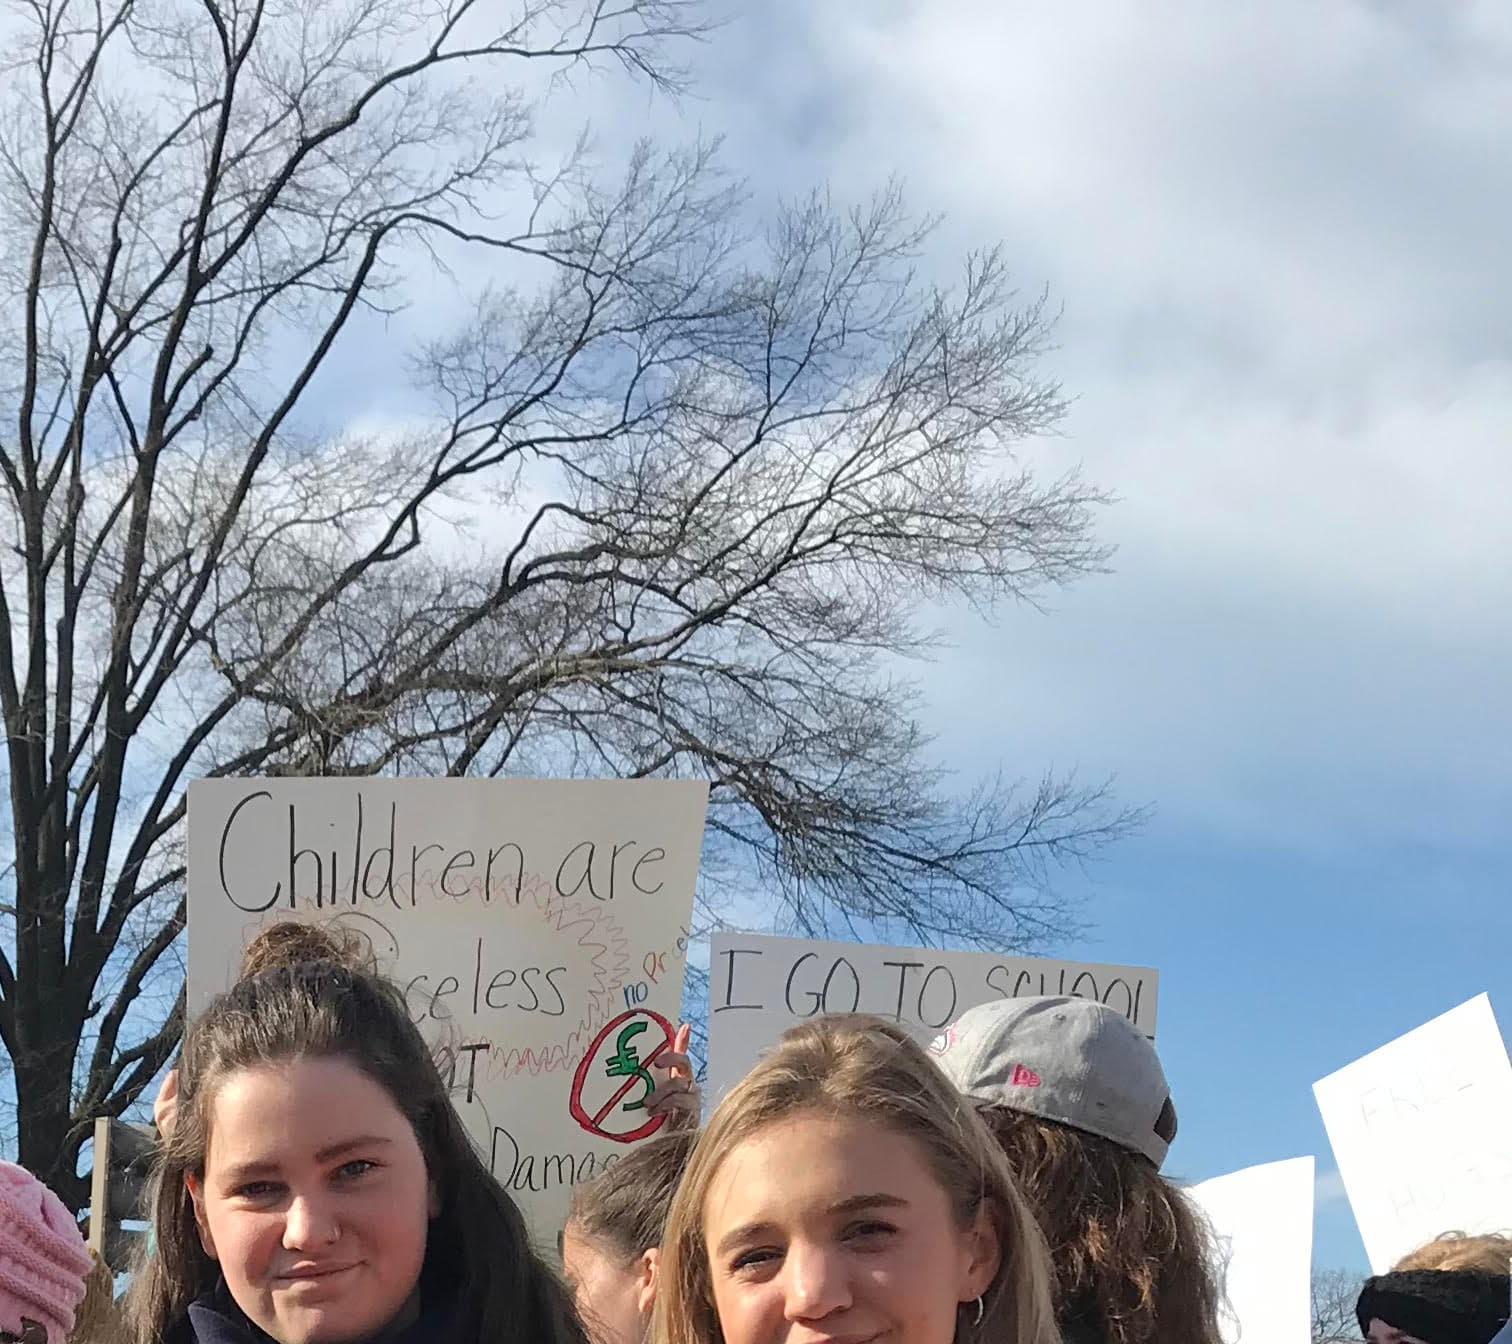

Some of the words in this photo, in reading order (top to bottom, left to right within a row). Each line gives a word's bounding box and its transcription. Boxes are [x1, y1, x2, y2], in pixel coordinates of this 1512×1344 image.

[219, 791, 527, 914] Children
[555, 840, 667, 902] are
[623, 981, 649, 1010] no
[714, 949, 764, 1013] I
[785, 951, 861, 1018] GO
[883, 961, 958, 1028] TO
